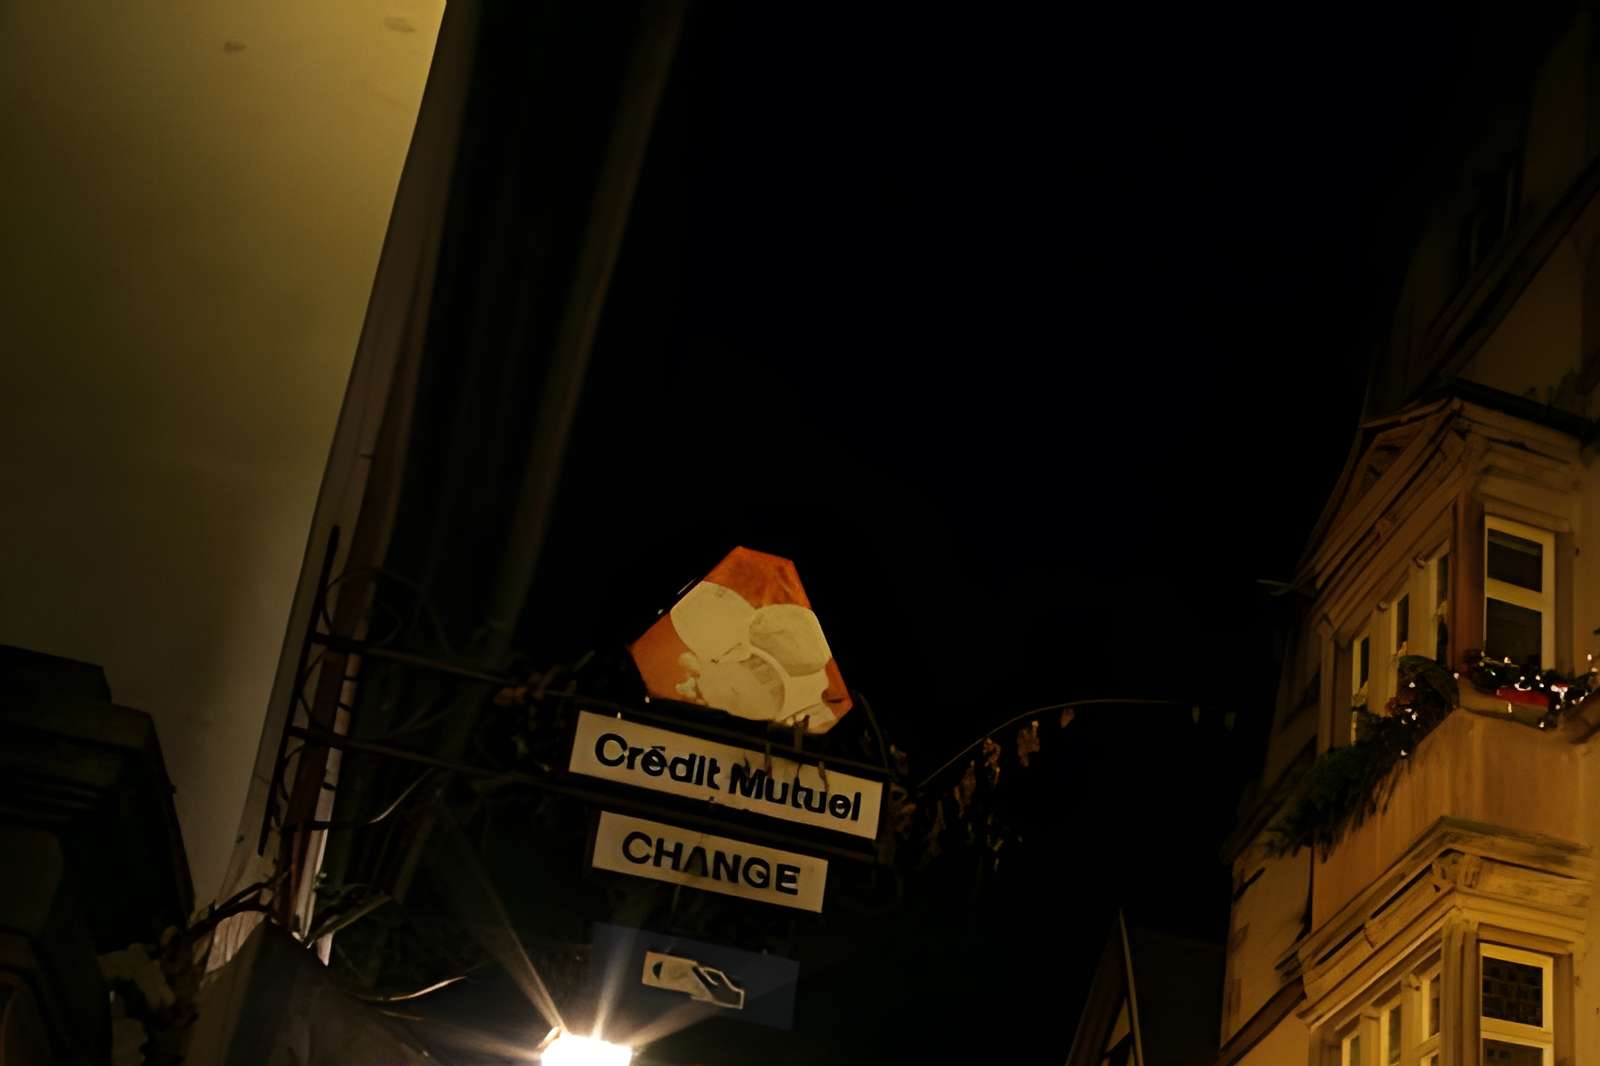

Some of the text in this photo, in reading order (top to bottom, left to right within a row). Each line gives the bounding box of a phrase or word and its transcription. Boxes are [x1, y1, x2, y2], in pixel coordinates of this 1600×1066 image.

[595, 733, 862, 822] Crédit Mutuel
[622, 832, 801, 895] CHANGE
